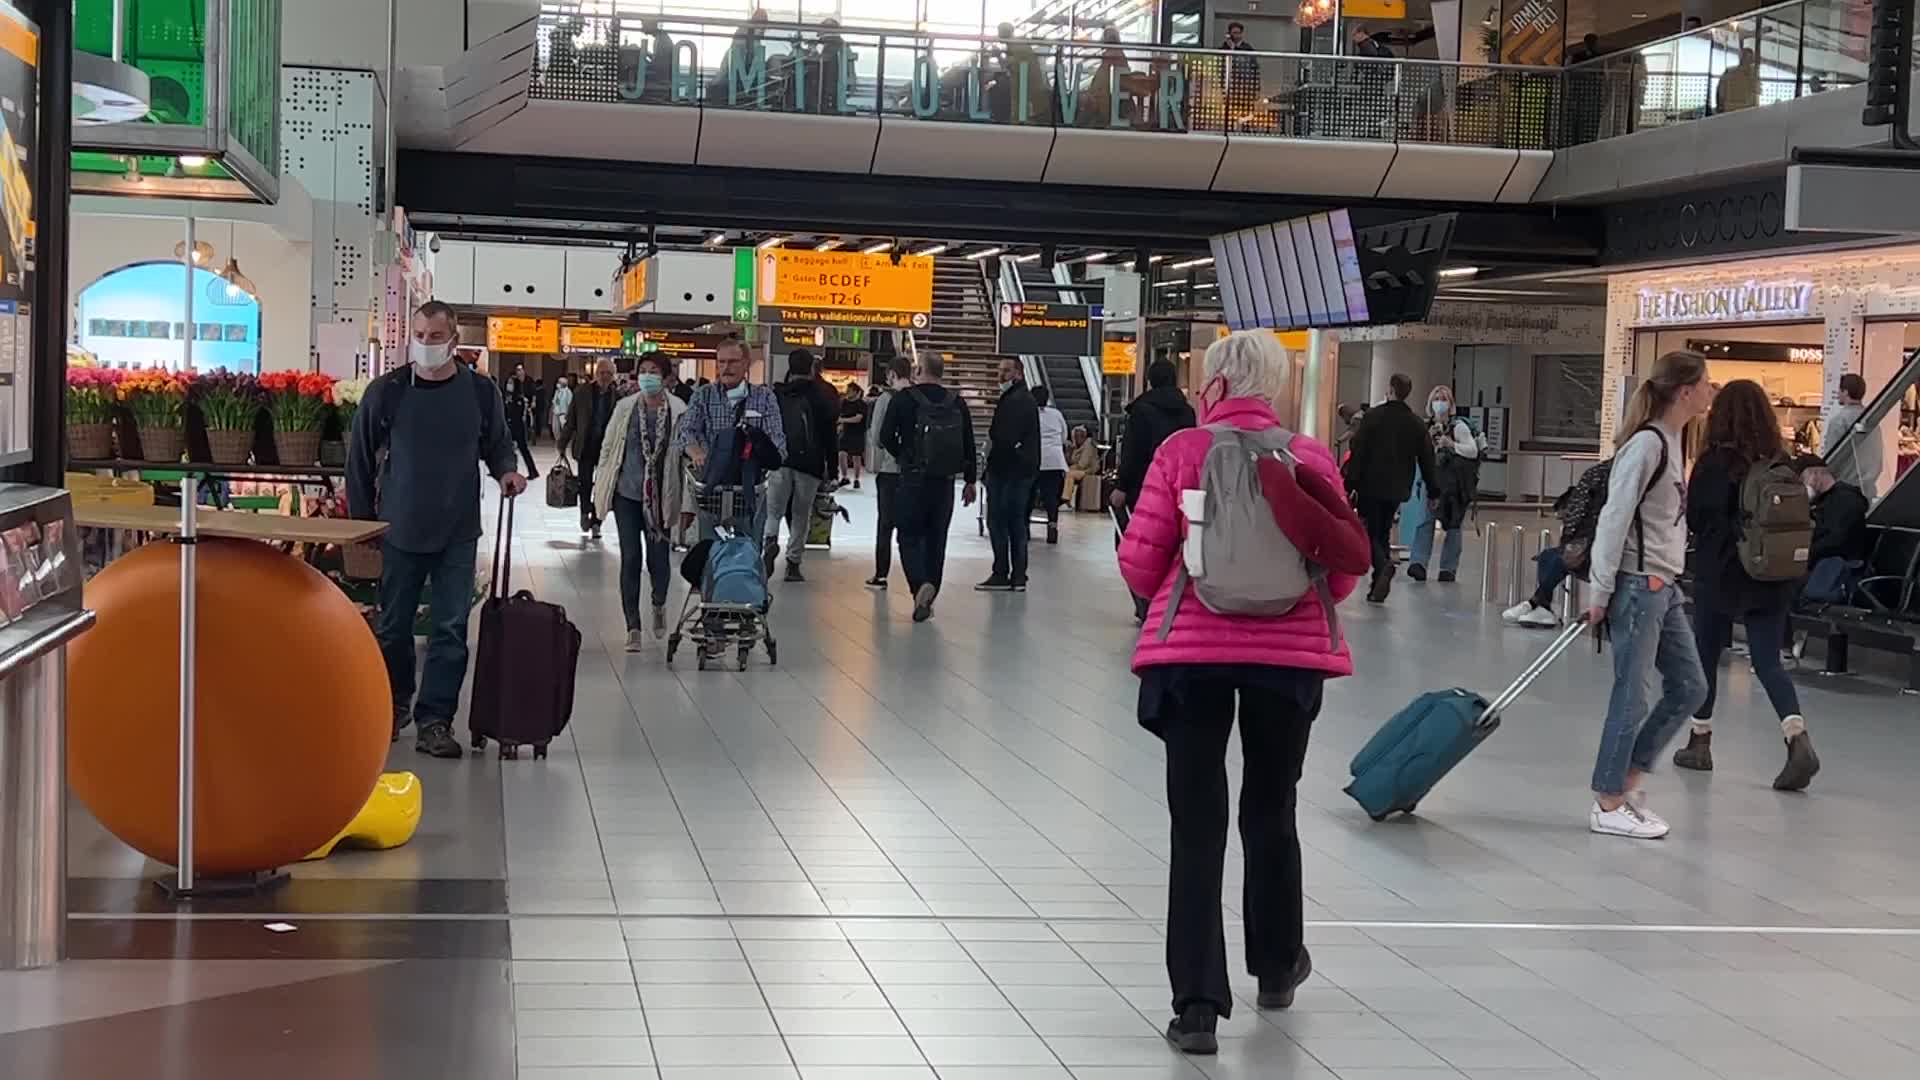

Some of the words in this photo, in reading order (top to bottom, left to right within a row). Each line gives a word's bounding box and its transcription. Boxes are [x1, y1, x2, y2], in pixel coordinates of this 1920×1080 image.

[1510, 0, 1550, 34] JAMIE
[1532, 7, 1559, 34] DELI
[618, 38, 858, 112] JAMIE
[911, 54, 1186, 130] OLIVER
[792, 274, 816, 283] Gates
[819, 273, 872, 288] BCDEF
[792, 292, 828, 301] Transfer
[830, 292, 862, 306] T2-6
[1633, 292, 1662, 320] THE
[1664, 289, 1731, 318] FASHION
[1734, 283, 1808, 313] GALLERY
[781, 310, 798, 319] Tax
[1790, 348, 1823, 360] BOSS
